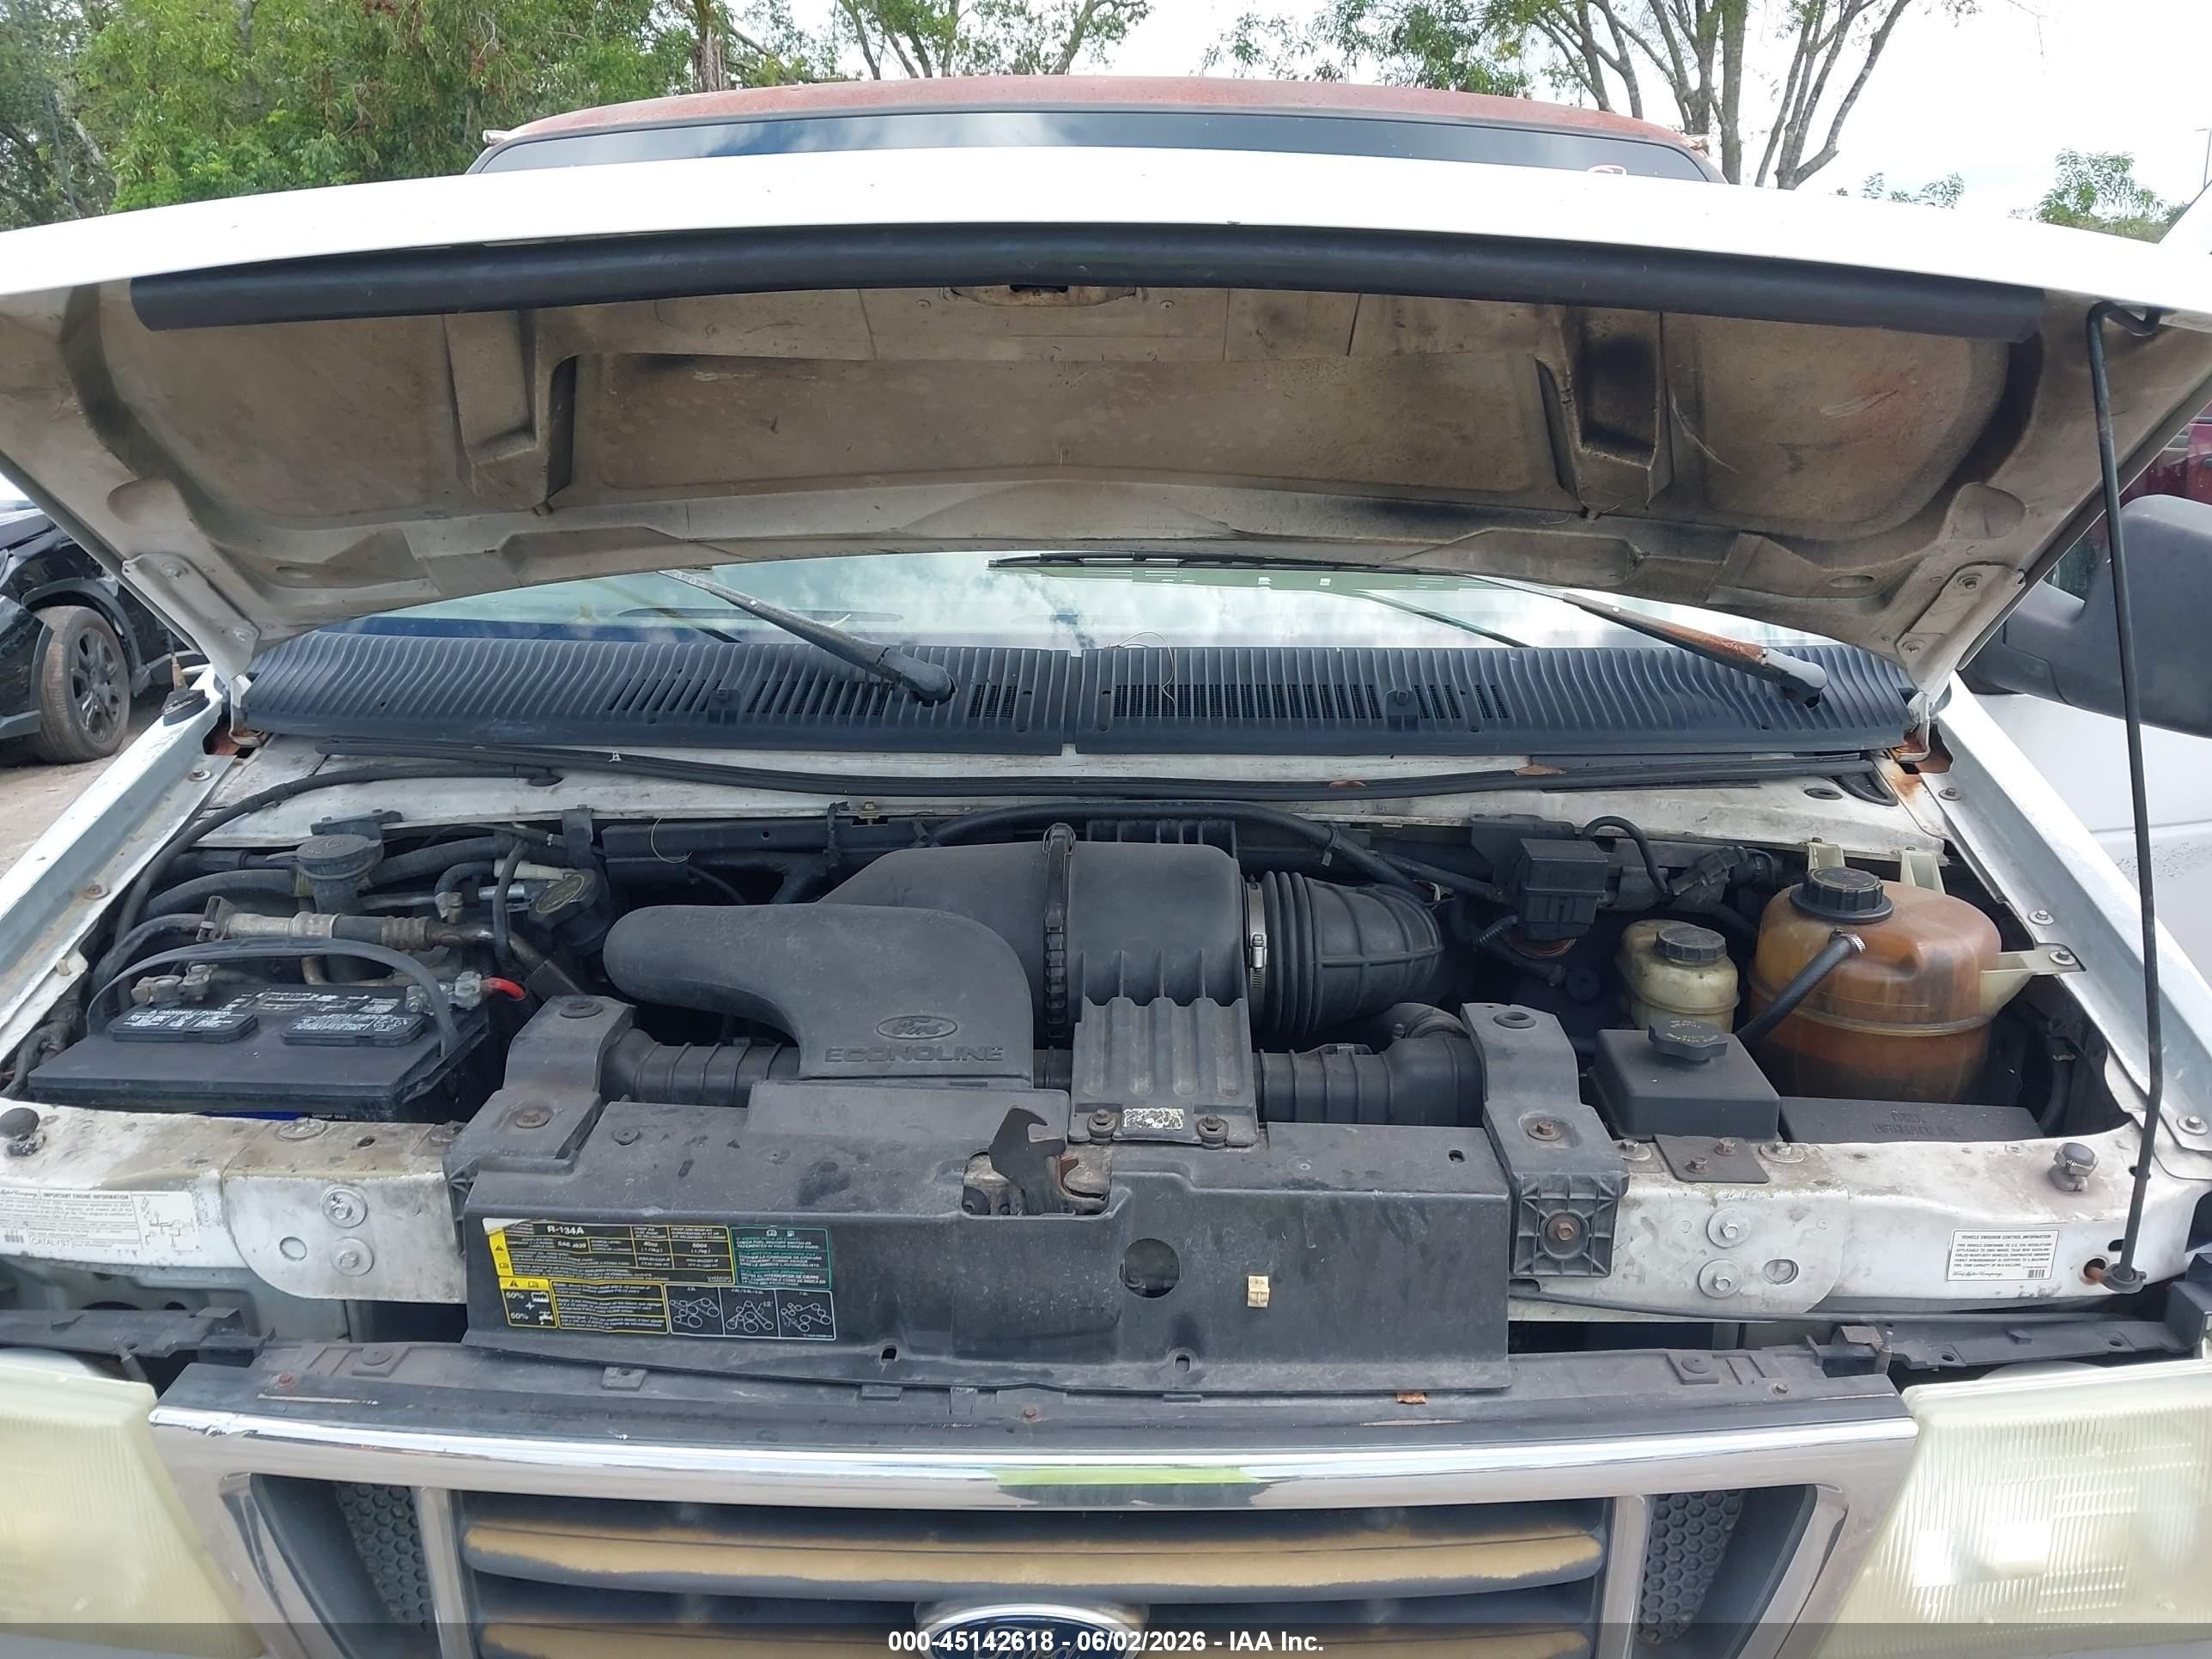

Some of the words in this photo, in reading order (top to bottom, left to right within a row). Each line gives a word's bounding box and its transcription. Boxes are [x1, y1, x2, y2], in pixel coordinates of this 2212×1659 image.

[891, 1018, 944, 1036] Ford
[824, 1045, 1004, 1062] ECONOLINE
[547, 1225, 585, 1235] R-134A
[506, 1291, 525, 1300] 50%
[510, 1312, 529, 1321] 50%
